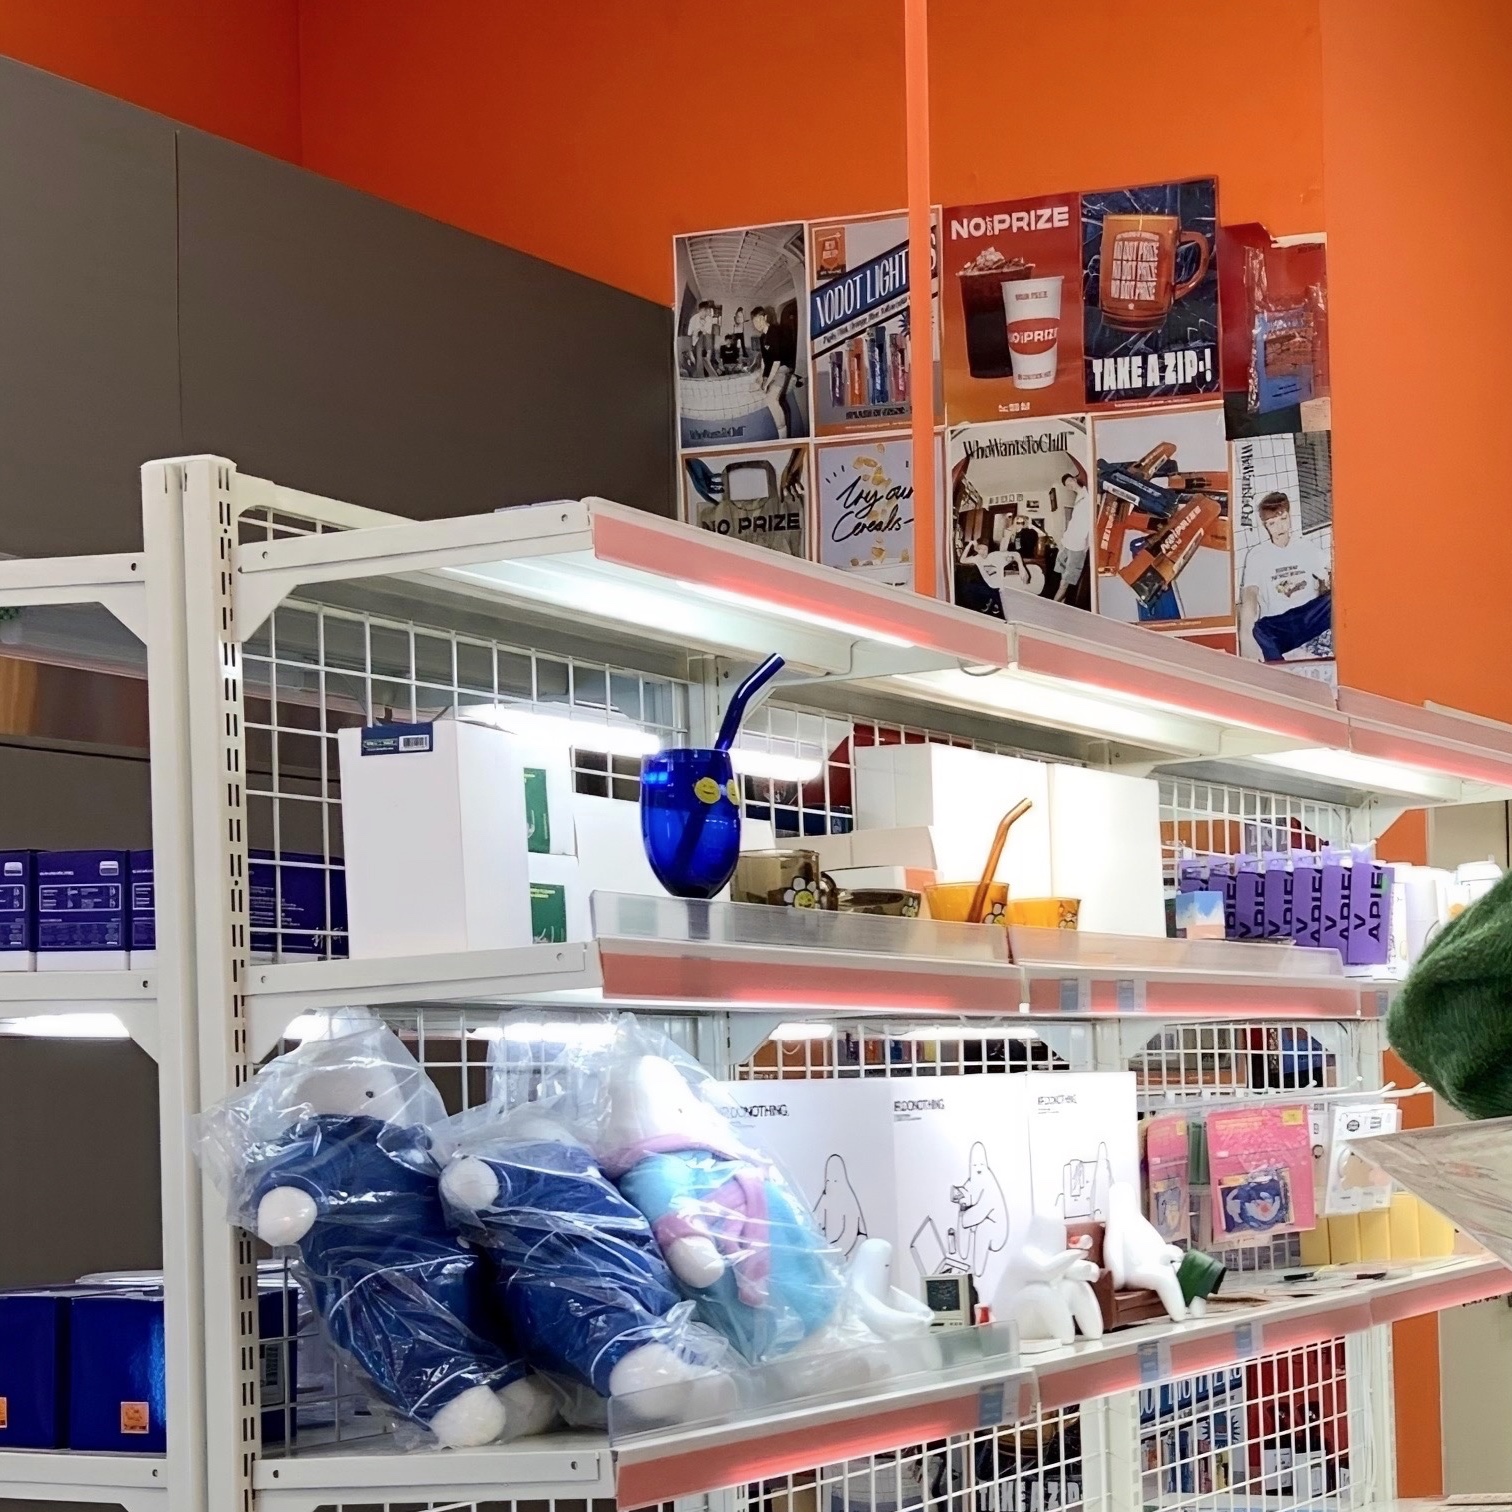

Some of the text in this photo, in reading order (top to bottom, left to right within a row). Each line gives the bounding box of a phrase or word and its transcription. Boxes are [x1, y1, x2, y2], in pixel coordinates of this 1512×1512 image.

[1093, 355, 1142, 391] TAKE
[1146, 353, 1160, 387] A
[738, 512, 800, 534] PRIZE
